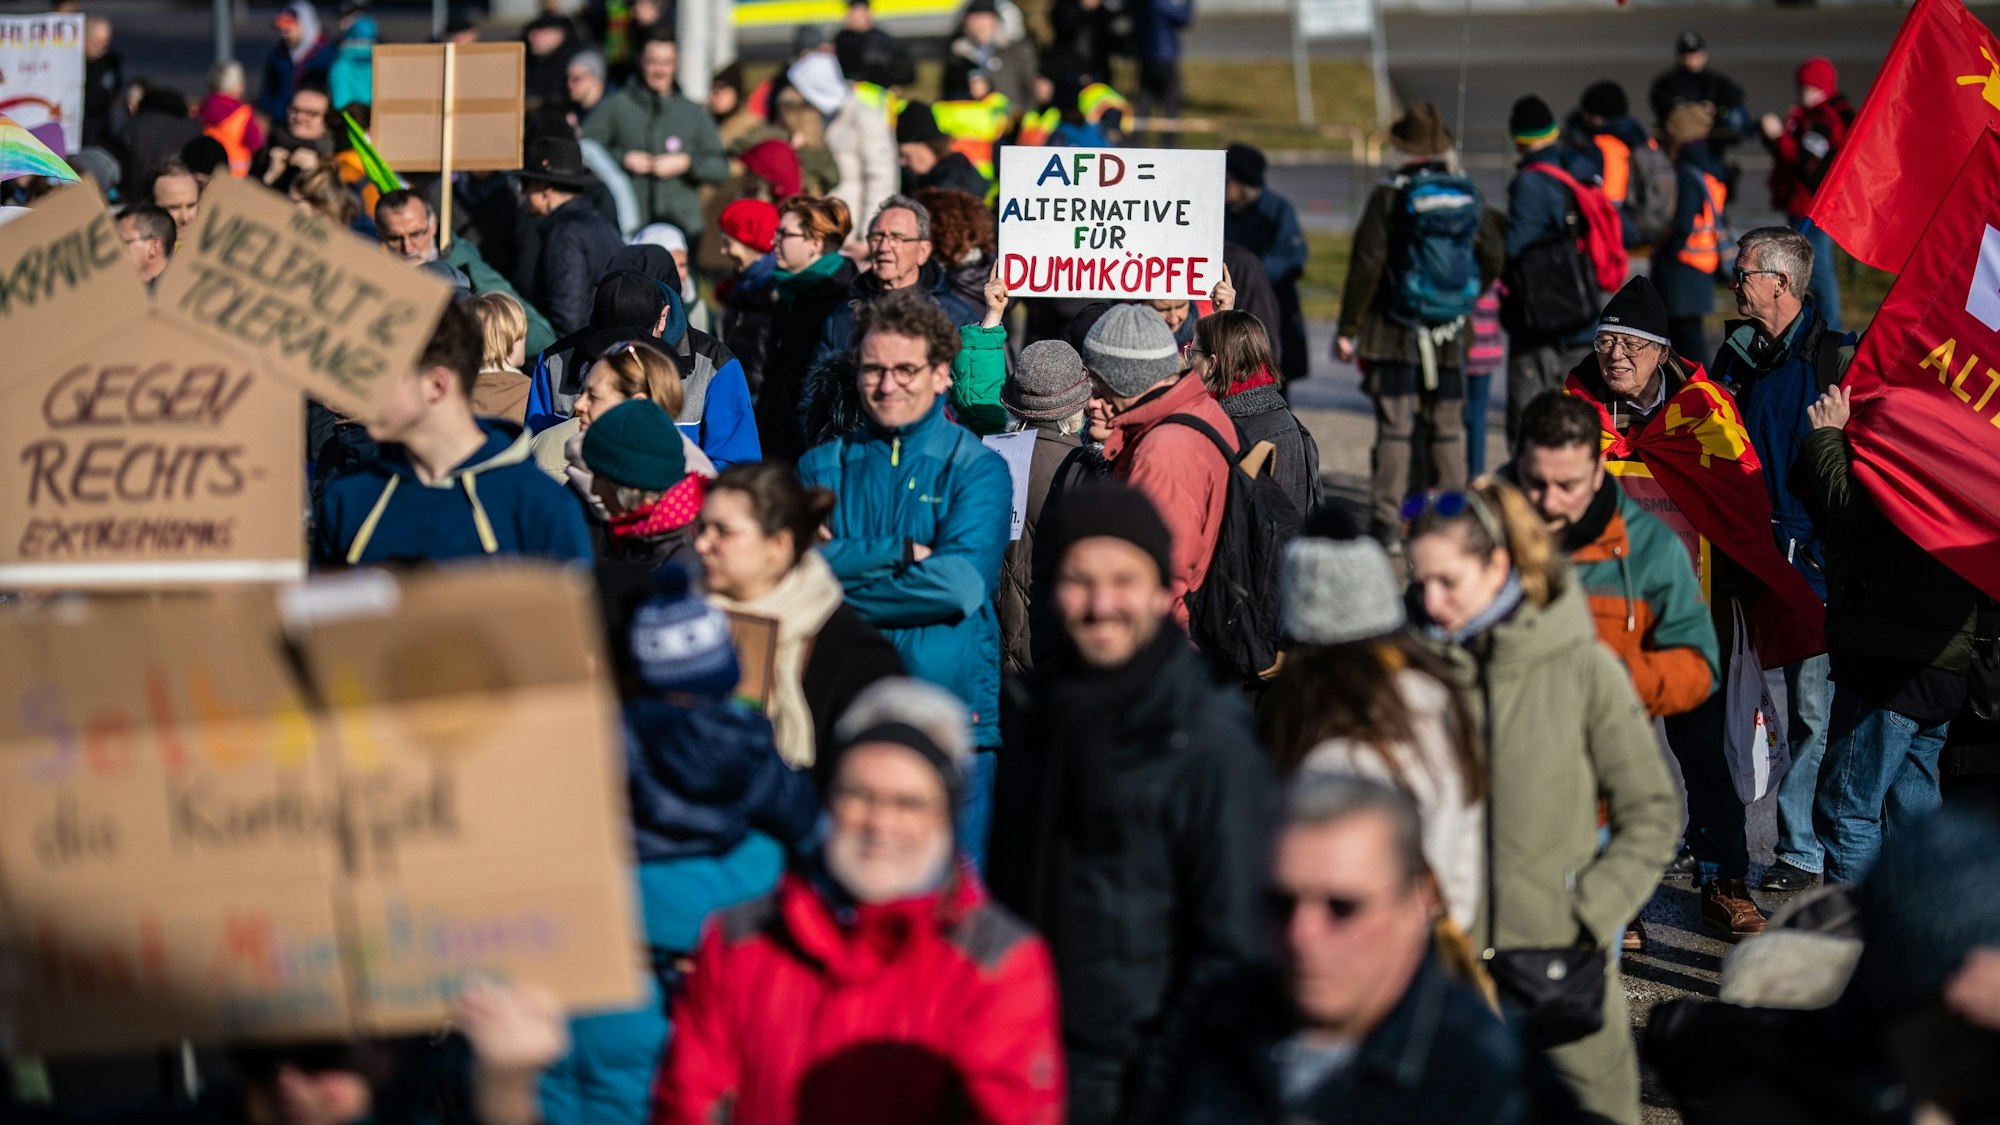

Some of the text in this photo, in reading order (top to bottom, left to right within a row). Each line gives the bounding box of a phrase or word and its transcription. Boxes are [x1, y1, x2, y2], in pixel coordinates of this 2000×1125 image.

[1037, 153, 1126, 187] AFD
[1001, 197, 1191, 226] ALTERNATIVE
[1074, 222, 1127, 249] FÜR
[198, 204, 384, 327] VIELFALT
[1004, 251, 1209, 296] DUMMKÖPFE
[177, 258, 389, 400] TOLERANZ
[42, 361, 256, 430] GEGEN
[1918, 337, 2000, 430] ALT
[20, 438, 268, 507] RECHTS-
